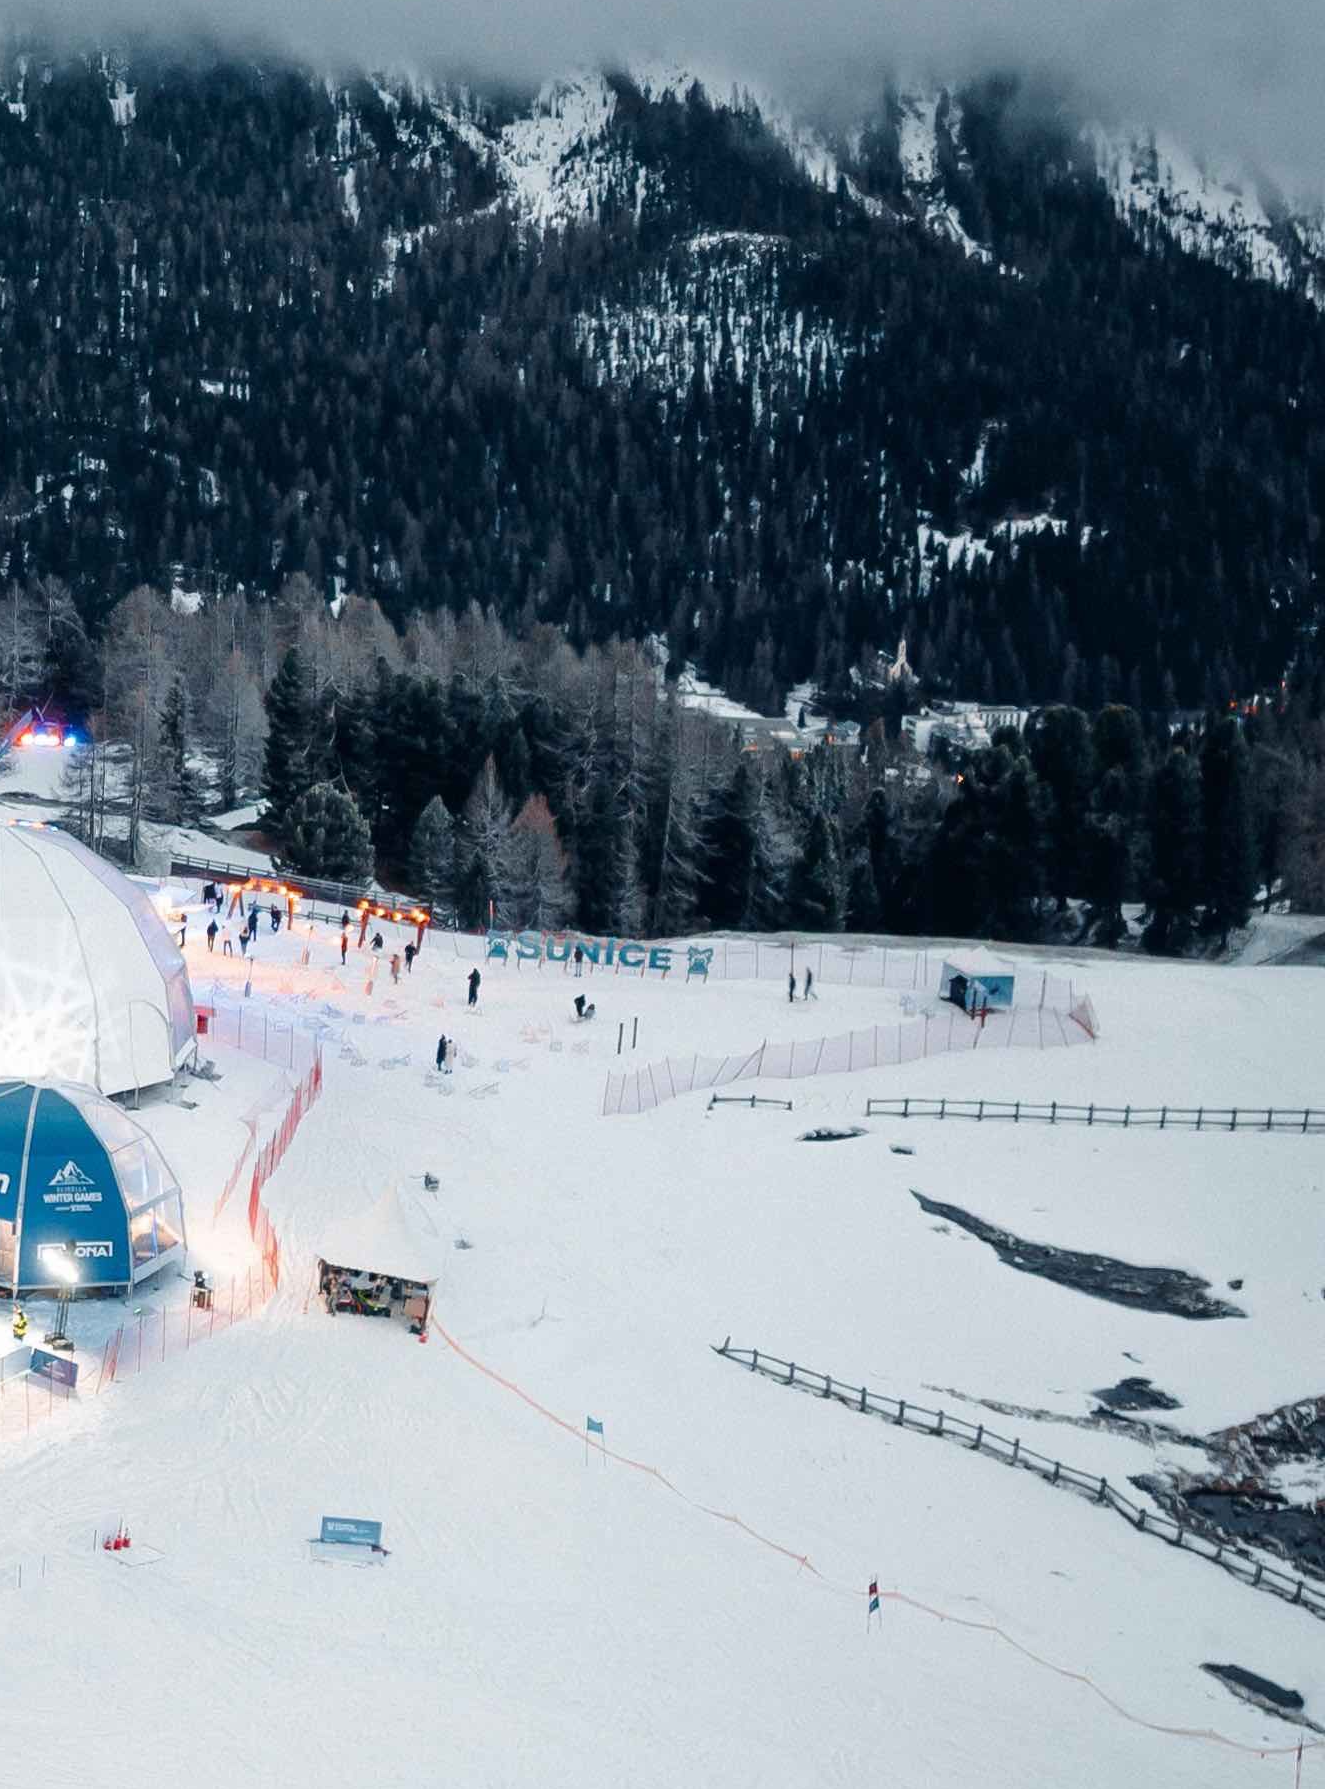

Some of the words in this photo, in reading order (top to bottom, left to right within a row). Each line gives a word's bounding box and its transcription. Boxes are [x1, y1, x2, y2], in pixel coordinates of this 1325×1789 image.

[516, 930, 673, 970] SUNICE
[43, 1193, 73, 1203] WINTER
[74, 1192, 102, 1202] GAMES
